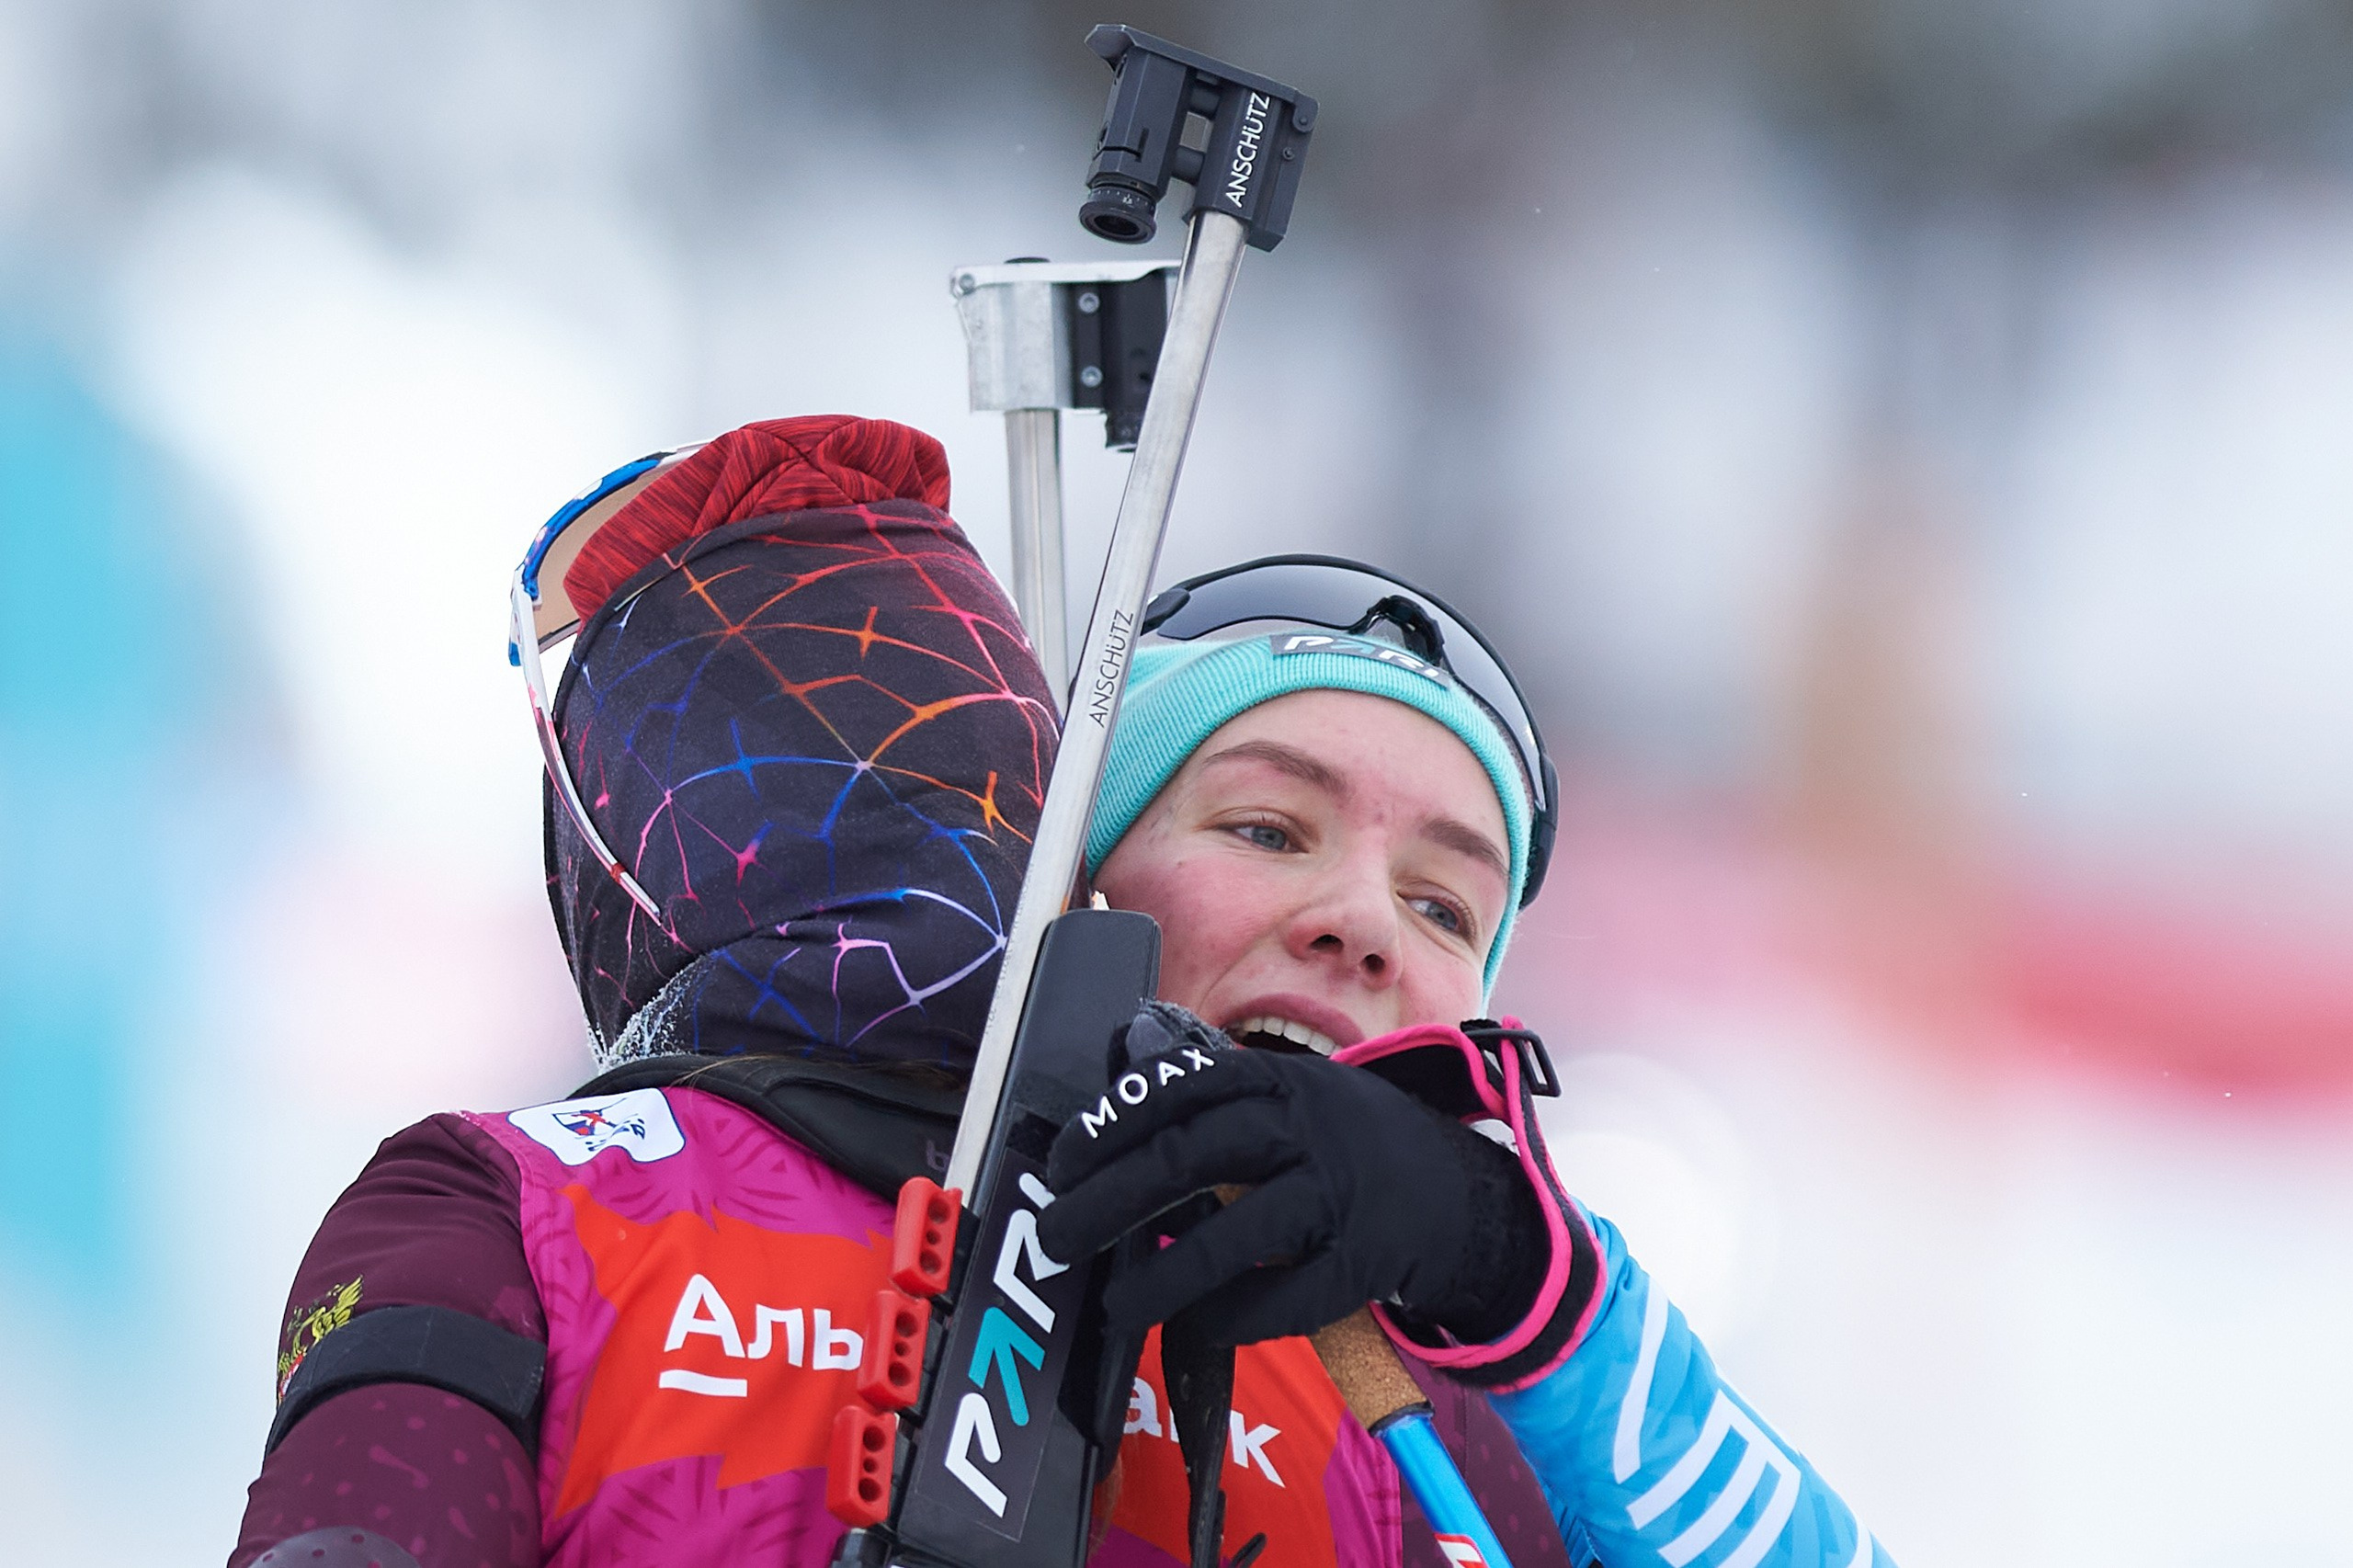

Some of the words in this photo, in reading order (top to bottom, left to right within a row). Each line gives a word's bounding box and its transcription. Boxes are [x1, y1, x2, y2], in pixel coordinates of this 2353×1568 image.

[1226, 92, 1270, 208] ANSCHÜTZ
[1089, 609, 1134, 728] ANSCHÜTZ
[1284, 635, 1439, 677] PARI
[1081, 1048, 1214, 1139] MOAX
